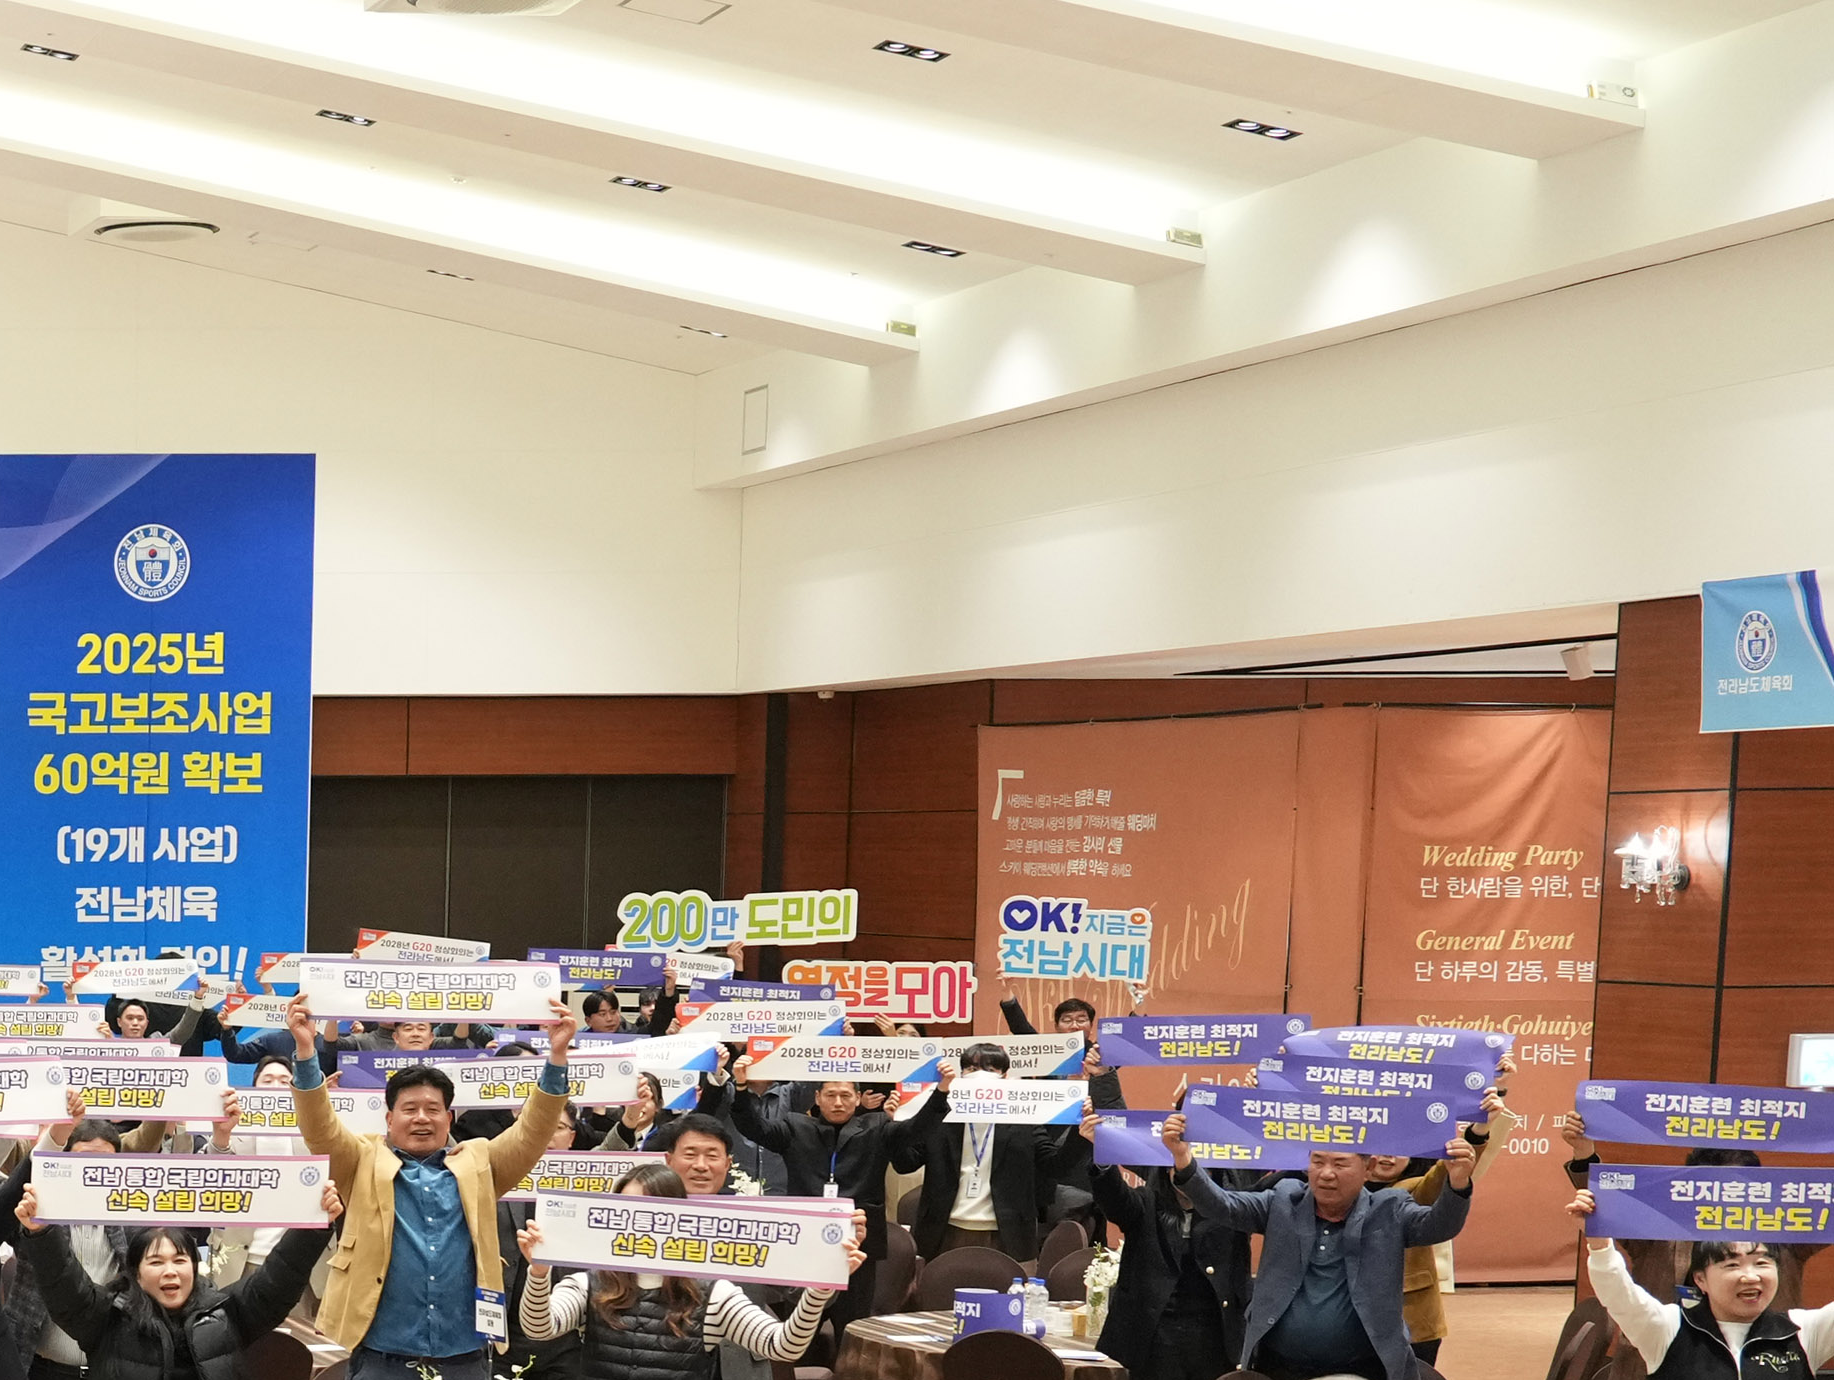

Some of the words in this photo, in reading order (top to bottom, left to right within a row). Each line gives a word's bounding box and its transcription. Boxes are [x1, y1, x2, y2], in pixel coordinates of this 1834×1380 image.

[119, 557, 138, 592] JEONNAM
[138, 587, 168, 597] SPORTS
[168, 557, 186, 589] COUNCIL
[77, 633, 224, 675] 2025년
[1717, 675, 1792, 695] 전라남도체육회
[27, 692, 272, 735] 국고보조사업
[34, 752, 169, 794] 60억원
[183, 752, 263, 794] 확보
[57, 827, 144, 864] (19개
[153, 827, 238, 864] 사업)
[1421, 845, 1517, 871] Wedding
[1524, 845, 1584, 871] Party
[1420, 877, 1438, 898] 단
[1446, 877, 1523, 899] 한사람을
[1529, 877, 1572, 899] 위한,
[75, 887, 217, 923] 전남체육
[1003, 899, 1082, 934] OK!
[1085, 912, 1148, 936] 지금은
[622, 896, 739, 945] 200만
[747, 893, 856, 942] 도민의
[1416, 930, 1504, 951] General
[1509, 931, 1574, 951] Event
[1001, 937, 1145, 980] 전남시대
[1414, 961, 1434, 983] 단
[1440, 961, 1498, 983] 하루의
[1505, 961, 1548, 983] 감동,
[894, 967, 972, 1021] 모아
[1521, 1045, 1577, 1065] 다하는
[1242, 1100, 1325, 1121] 전지훈련
[1331, 1104, 1389, 1125] 최적지
[1262, 1120, 1366, 1145] 전라남도!
[83, 1166, 124, 1188] 전남
[128, 1167, 164, 1188] 통합
[167, 1167, 279, 1189] 국립의과대학
[107, 1191, 150, 1211] 신속
[154, 1190, 196, 1212] 설립
[201, 1191, 251, 1213] 희망!
[1670, 1180, 1772, 1202] 전지훈련
[1781, 1182, 1834, 1203] 최적
[1695, 1206, 1828, 1231] 전라남도!
